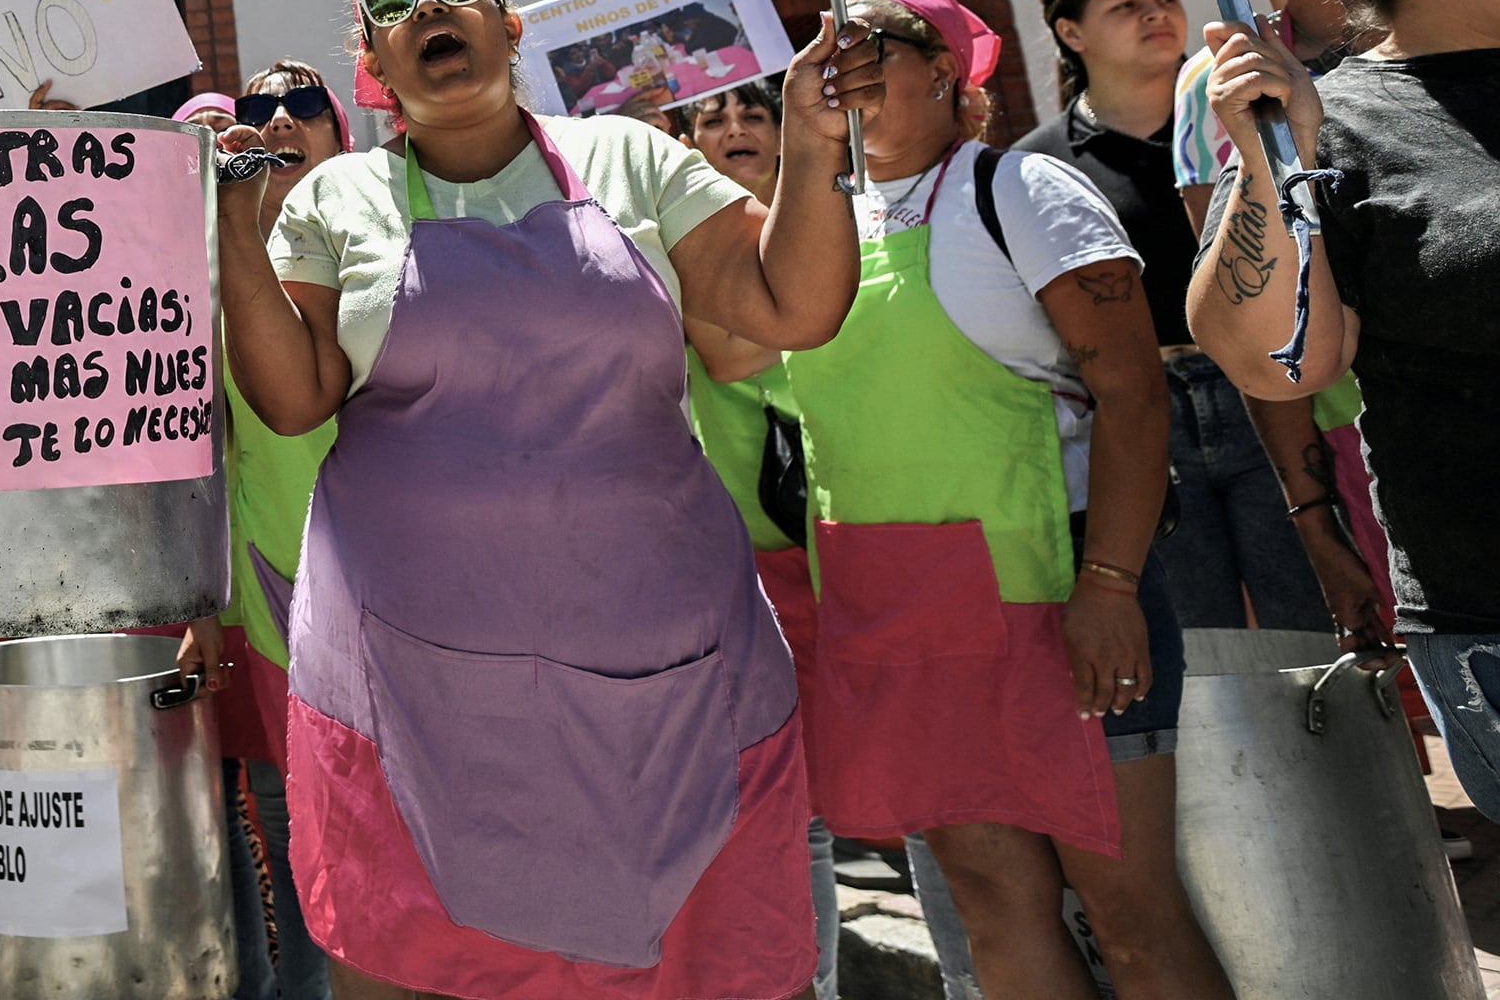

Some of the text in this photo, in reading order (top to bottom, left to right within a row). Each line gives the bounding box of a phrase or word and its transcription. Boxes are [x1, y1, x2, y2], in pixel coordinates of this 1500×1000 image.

[575, 5, 631, 34] NIÑOS
[10, 350, 109, 404] MAS
[124, 345, 208, 397] NUES
[18, 791, 85, 829] AJUSTE
